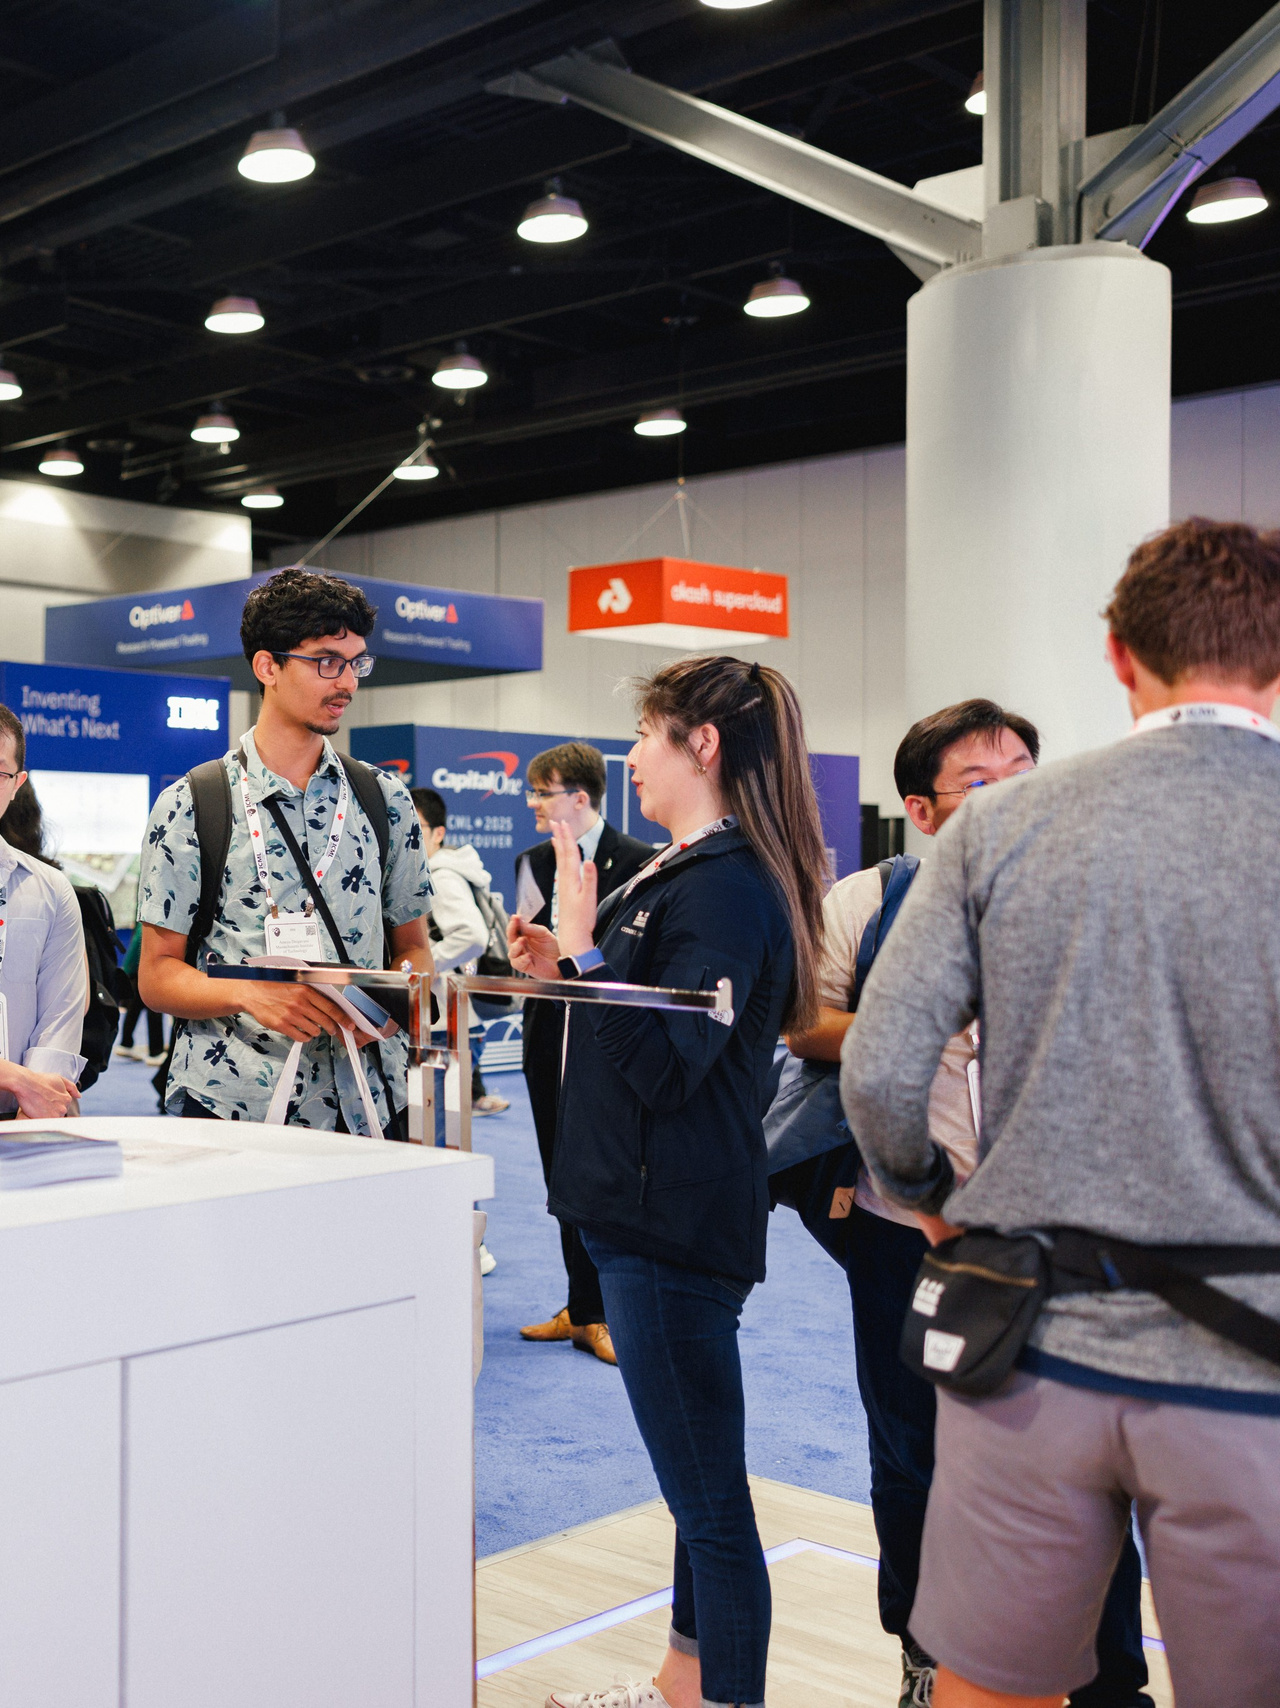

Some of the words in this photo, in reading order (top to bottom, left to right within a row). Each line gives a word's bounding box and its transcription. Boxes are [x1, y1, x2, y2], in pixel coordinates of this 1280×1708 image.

[394, 595, 446, 623] Optiver
[670, 580, 710, 605] akash
[712, 589, 783, 614] supercloud
[129, 603, 181, 630] Optiver
[21, 686, 100, 716] Inventing
[167, 696, 220, 731] IBM
[22, 713, 79, 737] What's
[79, 717, 120, 740] Next
[446, 814, 473, 831] CML
[328, 843, 337, 858] ICML
